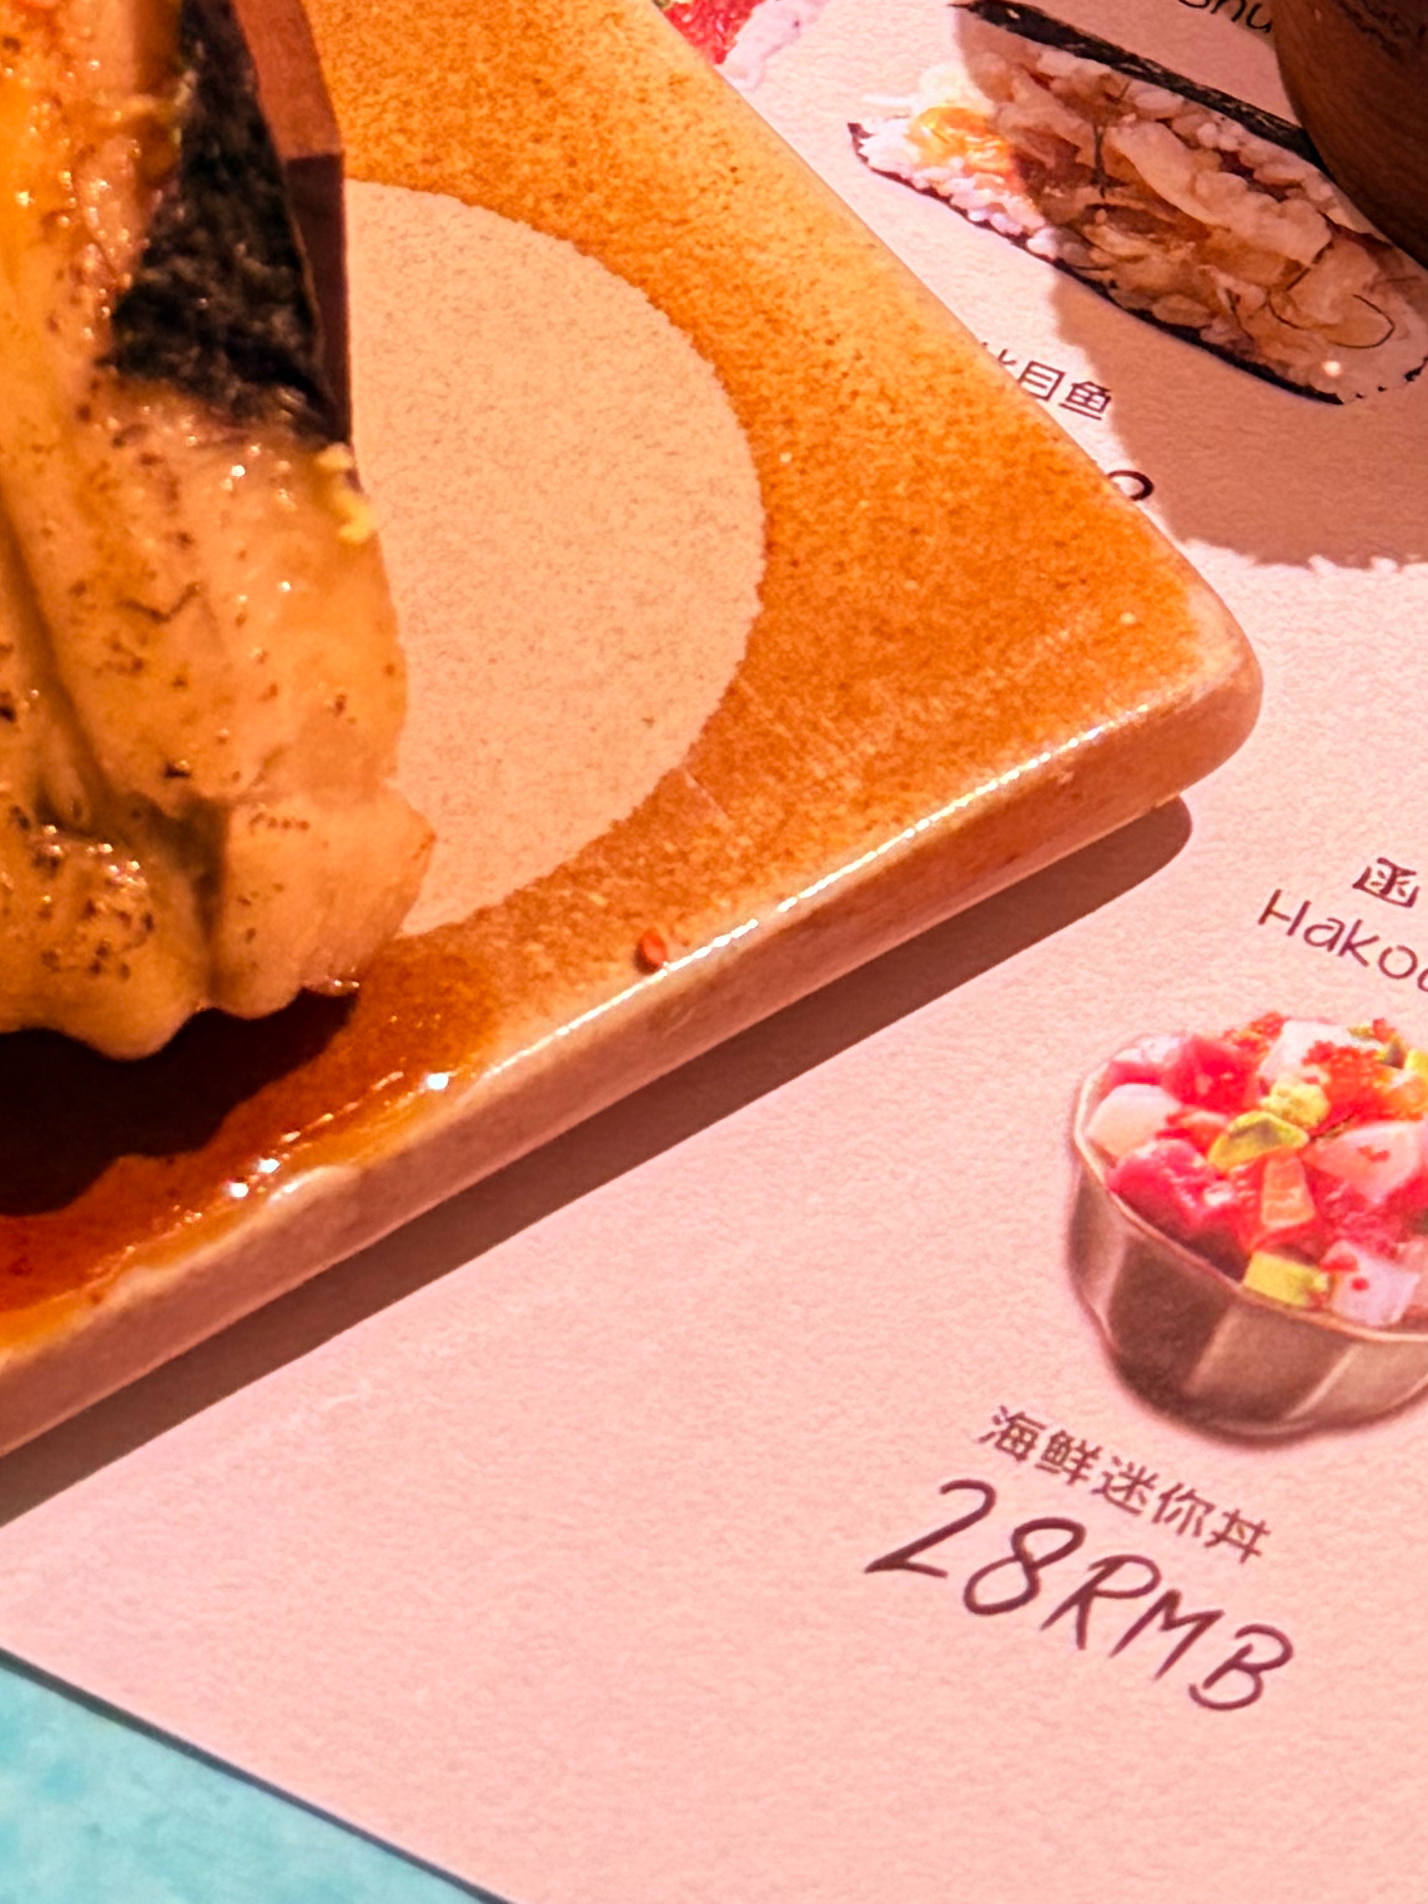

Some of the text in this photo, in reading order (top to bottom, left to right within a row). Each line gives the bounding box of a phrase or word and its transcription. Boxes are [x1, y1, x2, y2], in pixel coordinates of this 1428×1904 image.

[978, 1404, 1273, 1566] 海鲜迷你丼
[865, 1478, 1295, 1712] 28RMB
